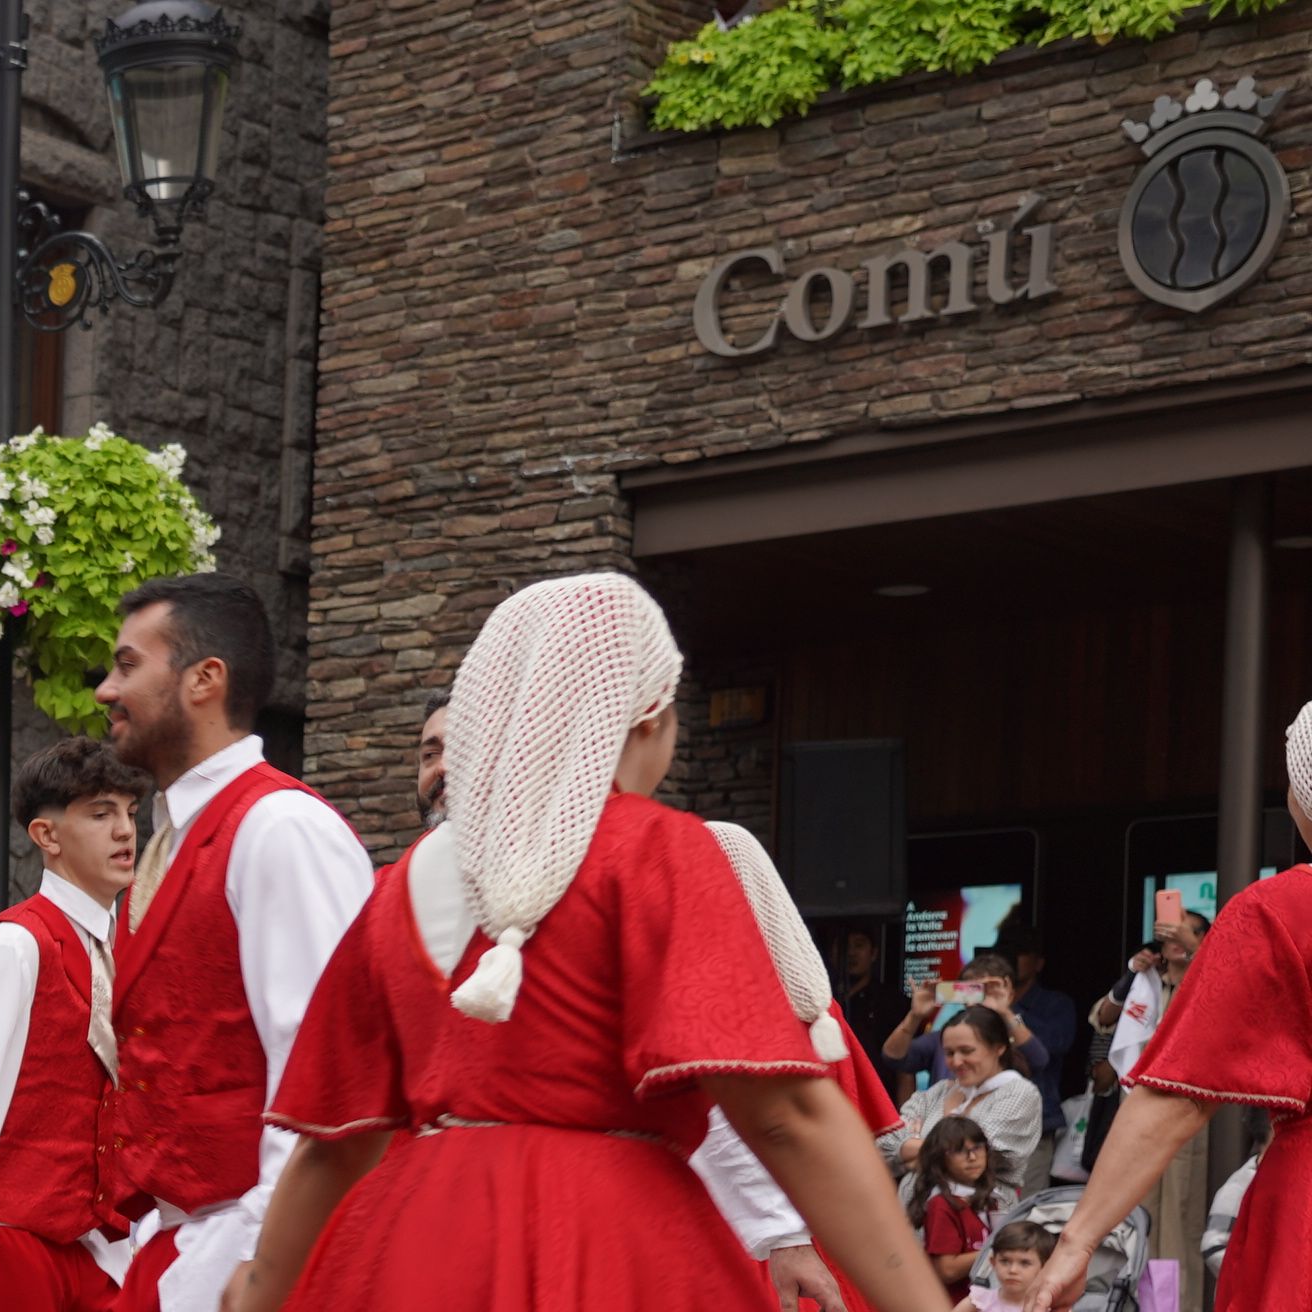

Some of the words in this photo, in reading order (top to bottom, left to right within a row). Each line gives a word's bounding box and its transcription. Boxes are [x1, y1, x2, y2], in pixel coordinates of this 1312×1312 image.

[693, 191, 1059, 358] Comú
[906, 910, 949, 921] Andorra
[905, 920, 916, 932] la
